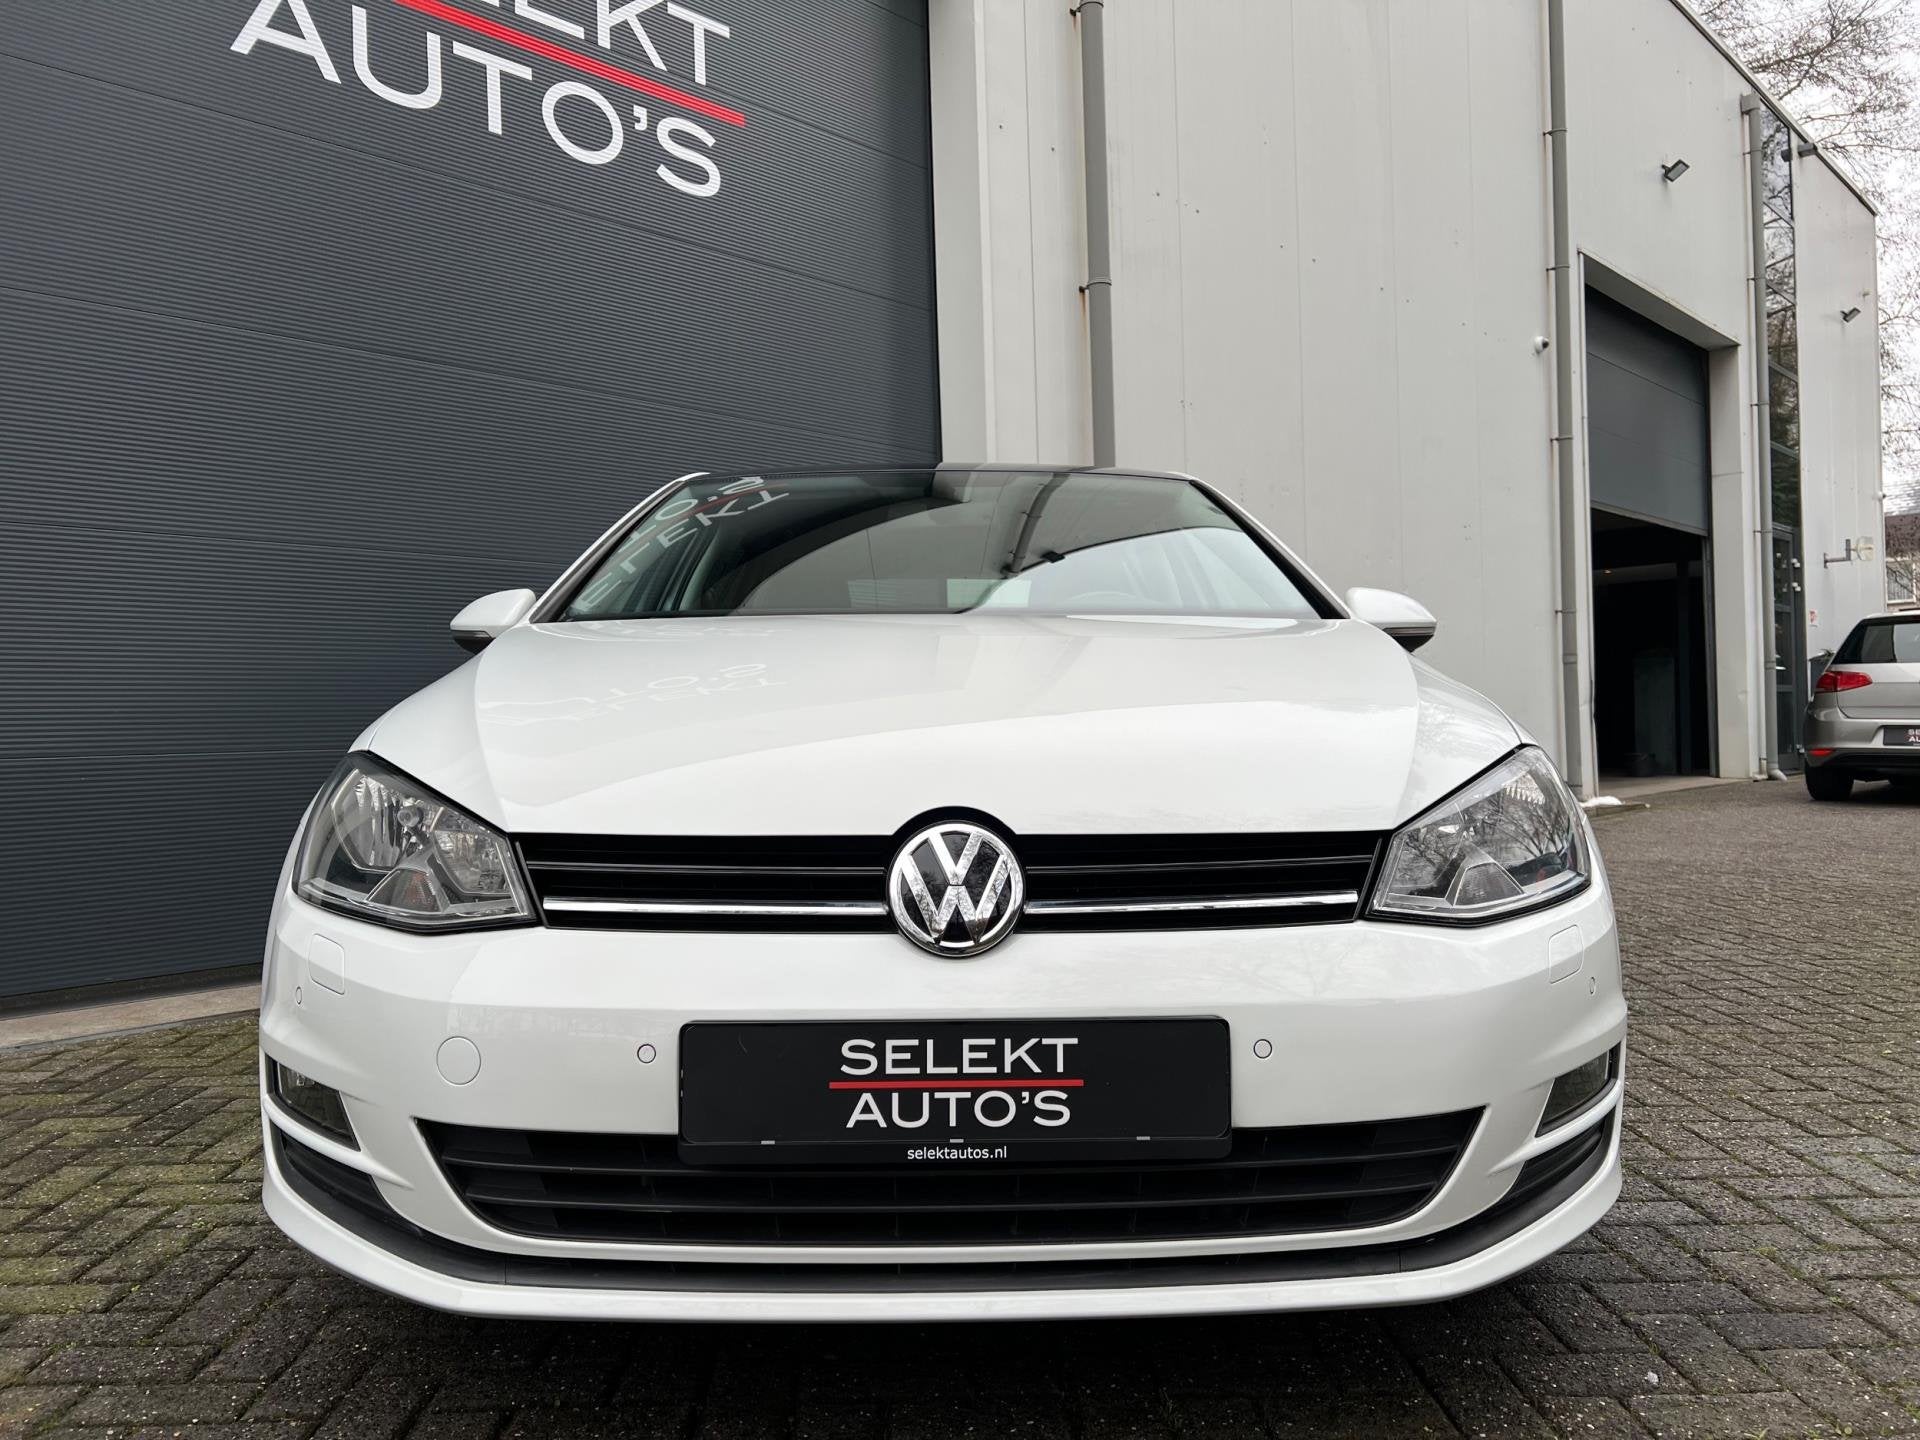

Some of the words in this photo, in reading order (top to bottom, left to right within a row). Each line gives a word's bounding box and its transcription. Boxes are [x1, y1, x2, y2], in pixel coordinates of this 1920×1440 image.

[893, 826, 1019, 950] VW
[840, 1037, 1079, 1076] SELEKT
[845, 1089, 1071, 1129] AUTO'S
[906, 1145, 1008, 1160] selektautos.nl
